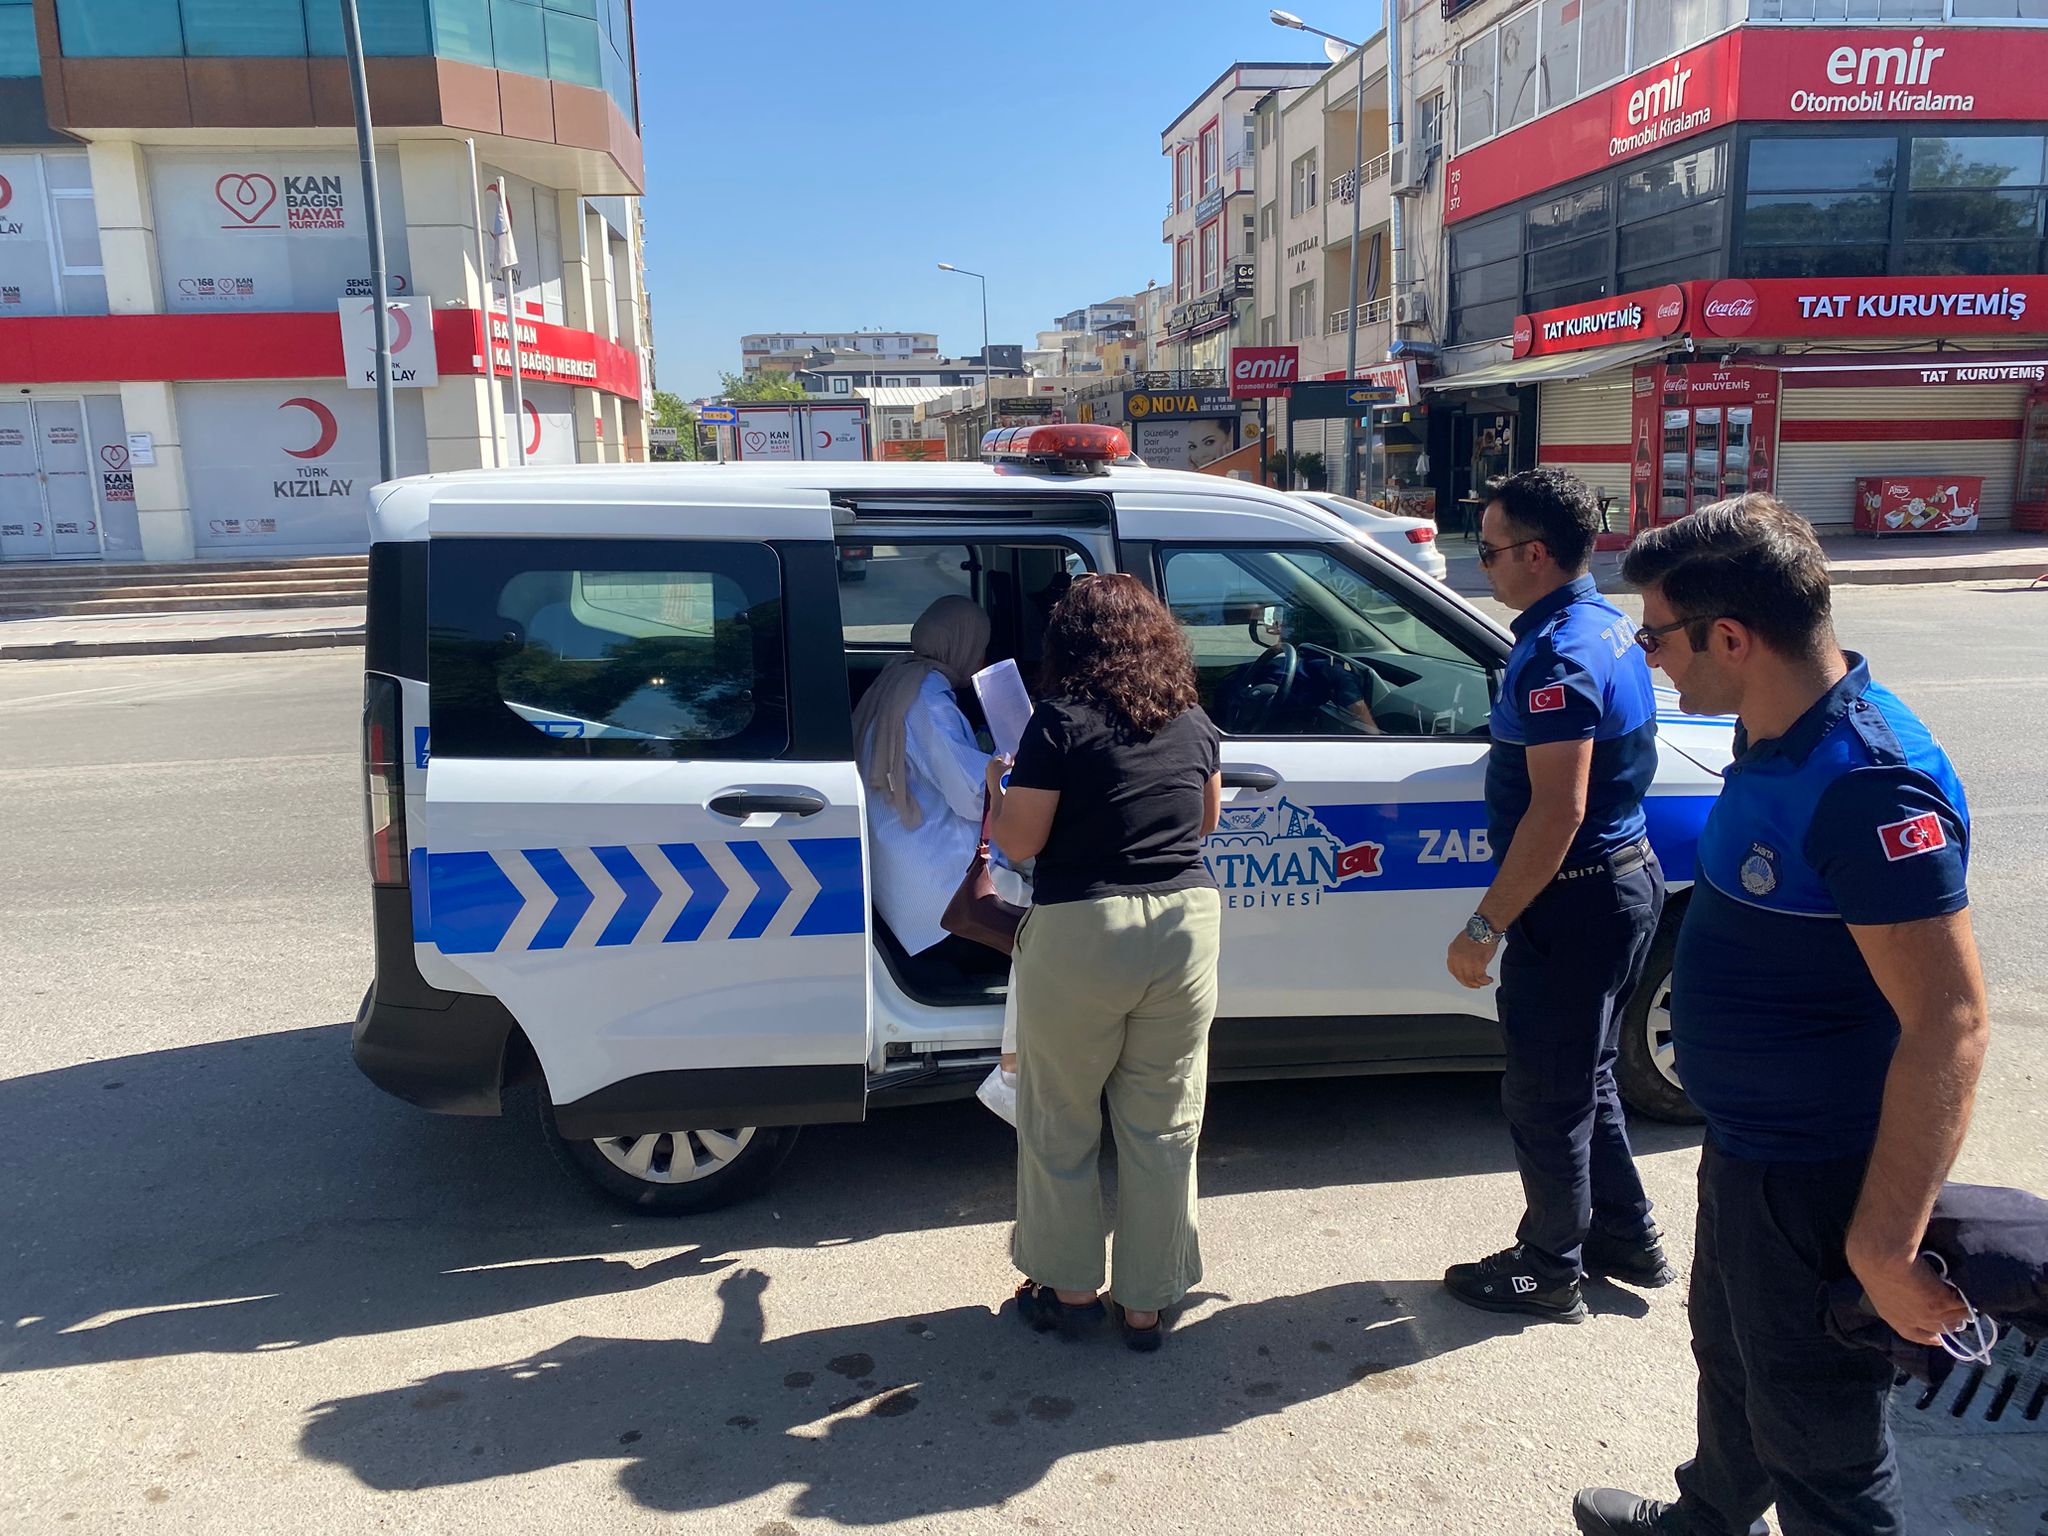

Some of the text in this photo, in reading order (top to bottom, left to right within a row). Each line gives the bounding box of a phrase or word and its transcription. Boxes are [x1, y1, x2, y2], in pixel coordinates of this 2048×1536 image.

[1826, 36, 1945, 85] emir
[1628, 60, 1692, 125] emir
[1790, 90, 1975, 112] Otomobil Kiralama
[1608, 106, 1711, 157] Otomobil Kiralama
[284, 176, 342, 194] KAN
[286, 194, 343, 208] BAĞIŞI
[287, 208, 343, 220] HAYAT
[289, 220, 345, 229] KURTARIR
[1657, 301, 1680, 319] Coca-Cola
[1705, 299, 1756, 317] Coca-Cola
[1798, 287, 2027, 320] TAT KURUYEMİŞ
[1543, 302, 1641, 340] TAT KURUYEMİŞ
[557, 357, 597, 378] MERKEZİ
[1235, 355, 1295, 378] emir
[1663, 378, 1688, 391] Coca-Cola
[1712, 372, 1731, 381] TAT
[1920, 370, 1948, 382] TAT
[1692, 380, 1750, 391] KURUYEMİŞ
[1152, 396, 1198, 413] NOVA
[103, 474, 133, 483] KAN
[296, 466, 329, 477] TÜRK
[273, 480, 353, 497] KIZILAY
[1231, 815, 1250, 824] 1955
